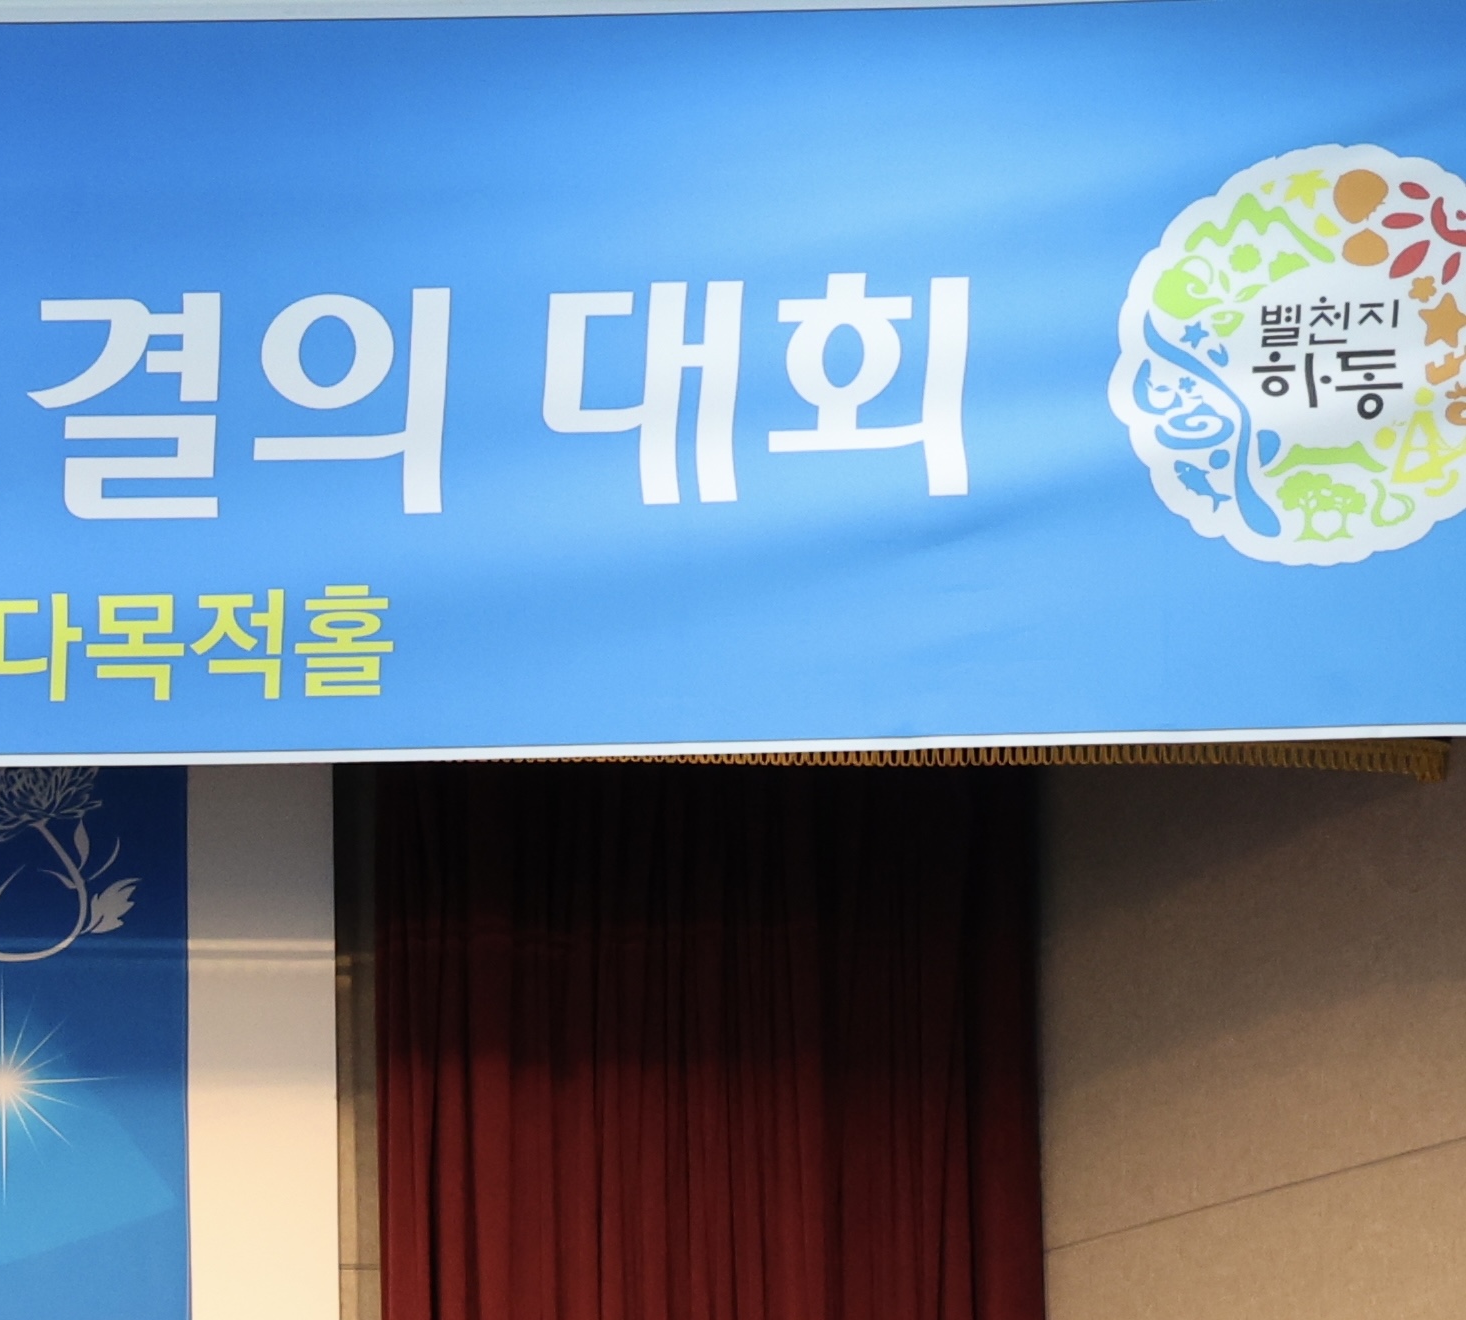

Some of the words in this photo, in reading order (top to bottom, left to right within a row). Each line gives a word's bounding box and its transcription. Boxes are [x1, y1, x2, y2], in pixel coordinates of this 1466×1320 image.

[1259, 295, 1401, 349] 별천지
[542, 272, 970, 505] 대회
[1251, 348, 1404, 421] 하동
